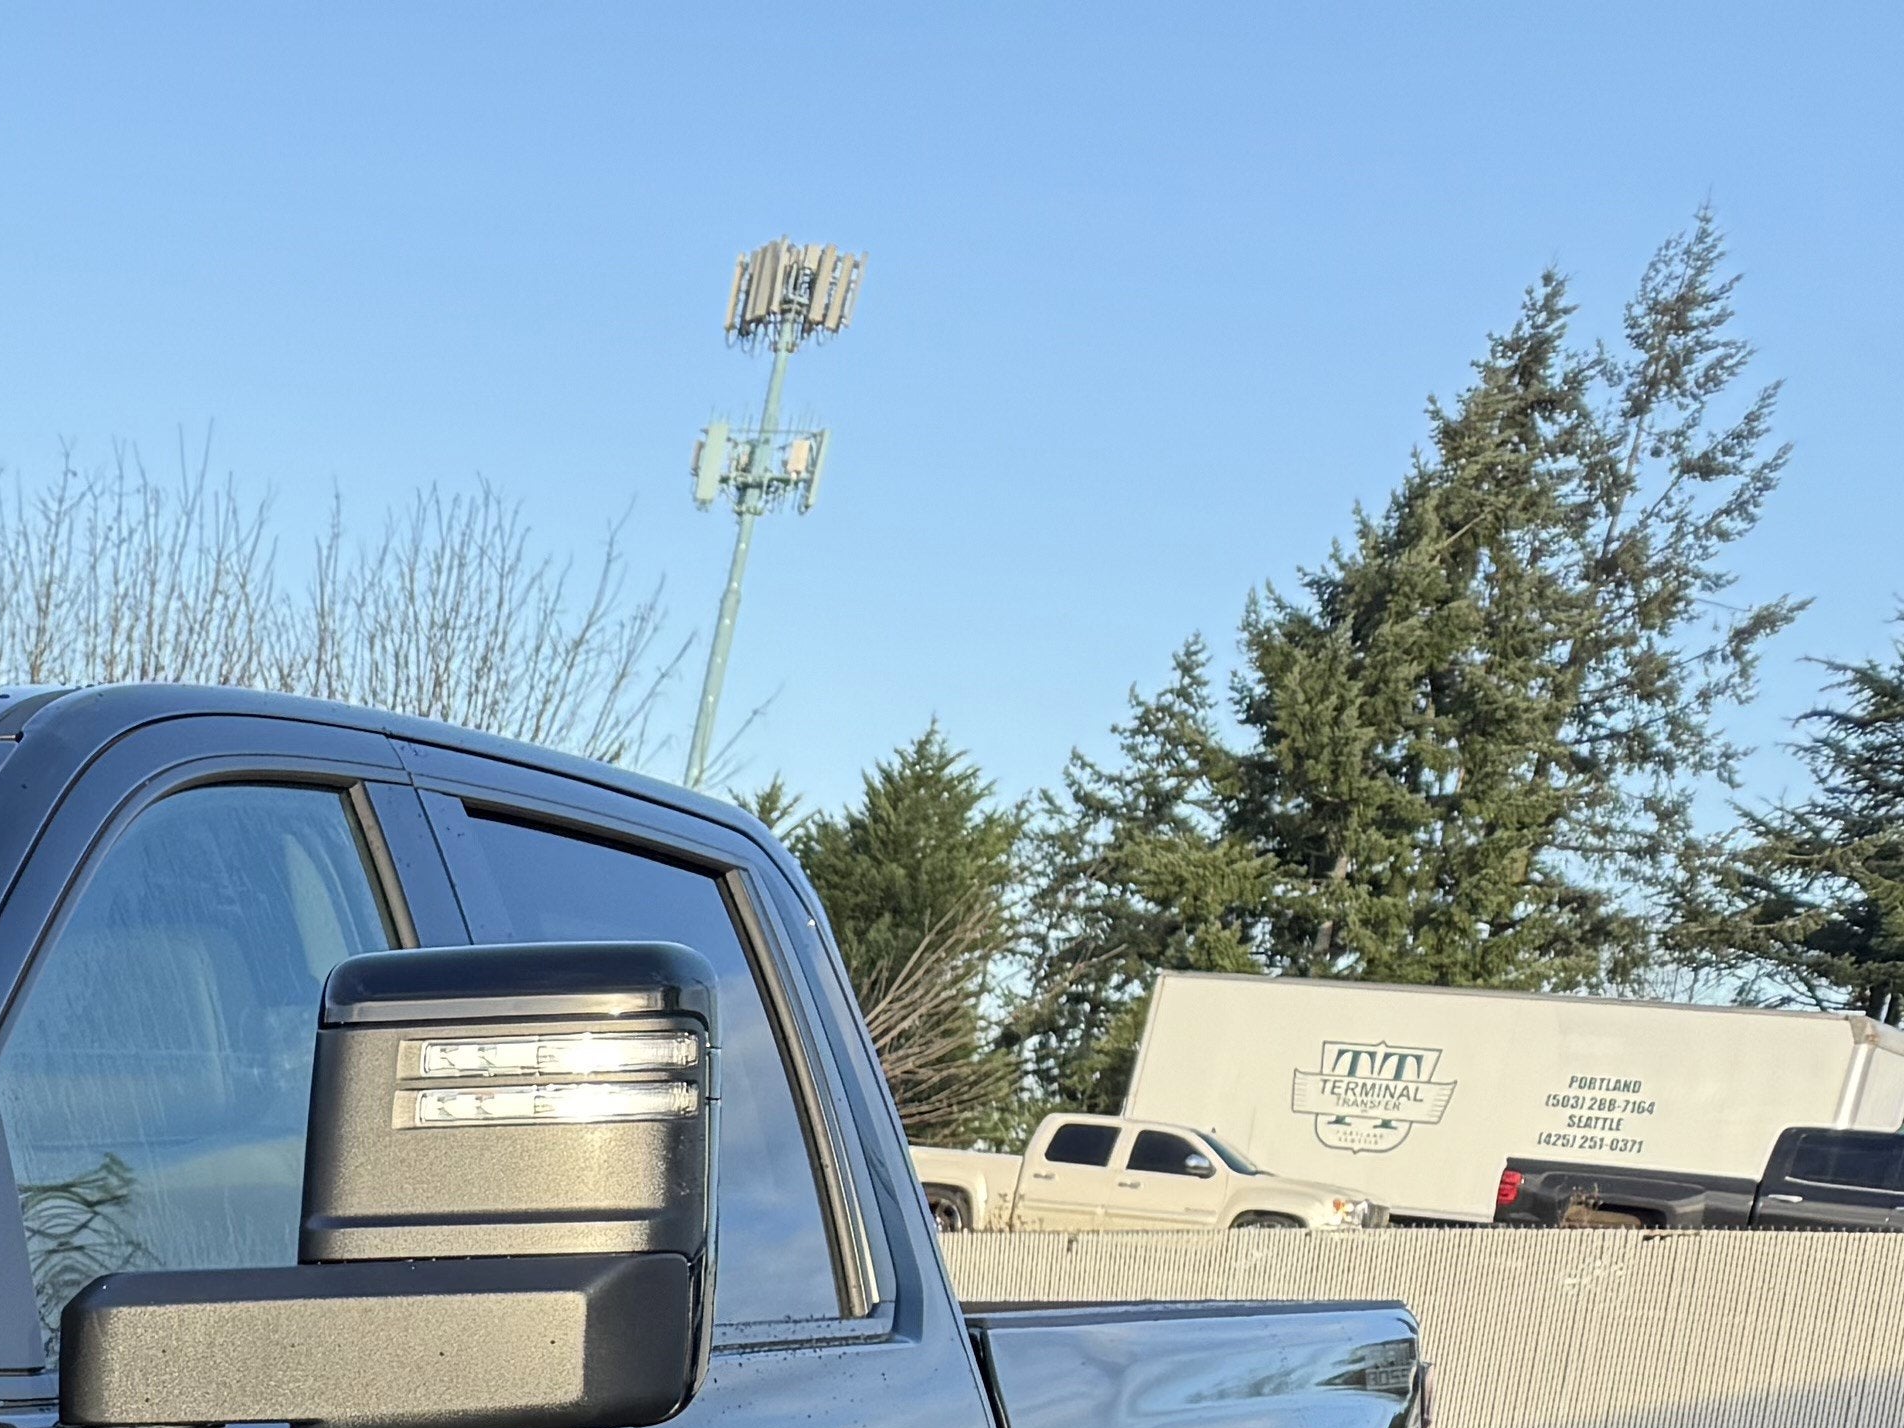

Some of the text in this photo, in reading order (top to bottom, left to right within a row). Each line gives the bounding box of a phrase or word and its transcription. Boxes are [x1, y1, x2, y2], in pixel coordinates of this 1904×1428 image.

[1320, 1078, 1424, 1103] TERMINAL
[1568, 1075, 1642, 1094] PORTLAND
[1335, 1093, 1402, 1112] TRANSFER
[1545, 1093, 1656, 1115] (503) 288-7164
[1567, 1114, 1624, 1131] SEATTLE
[1537, 1131, 1644, 1154] (425) 251-0371
